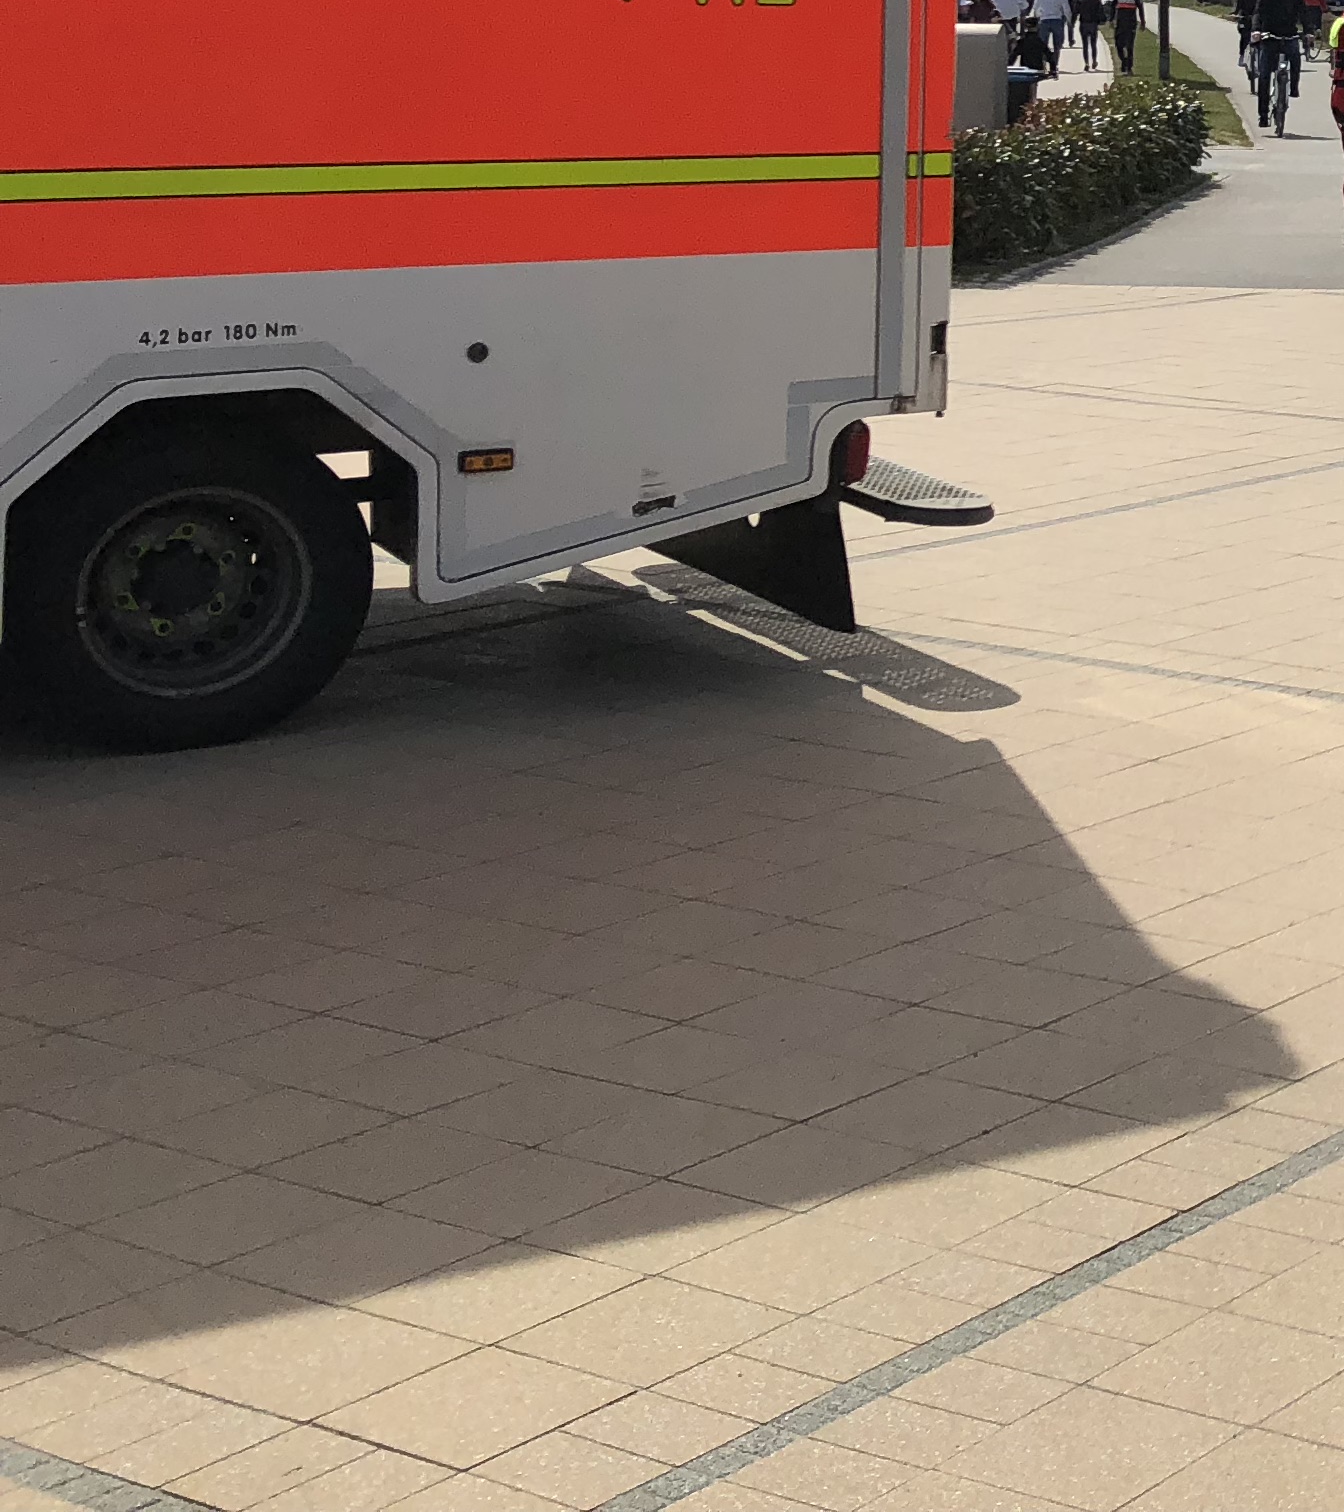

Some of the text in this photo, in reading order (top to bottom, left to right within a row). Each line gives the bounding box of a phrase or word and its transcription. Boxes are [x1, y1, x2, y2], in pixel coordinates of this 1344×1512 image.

[138, 322, 298, 349] 4,2 bar 180 Nm
